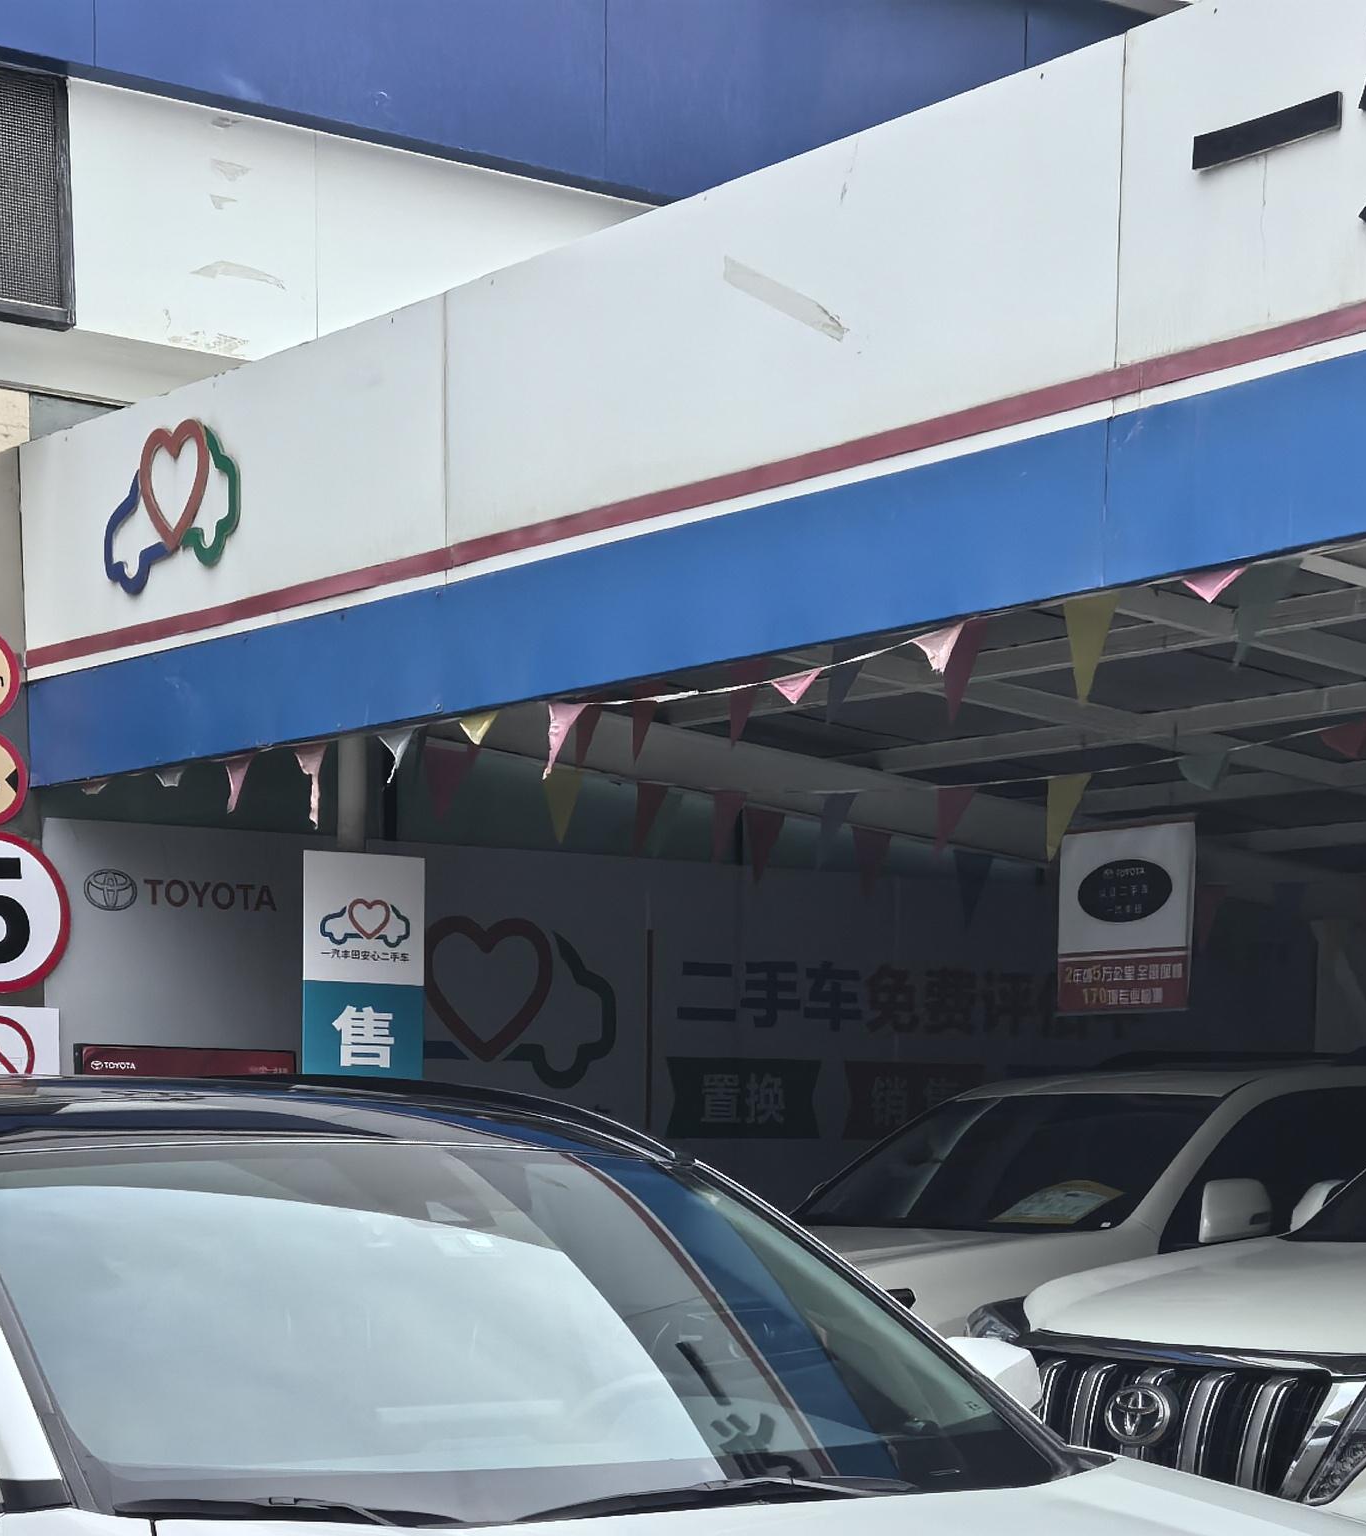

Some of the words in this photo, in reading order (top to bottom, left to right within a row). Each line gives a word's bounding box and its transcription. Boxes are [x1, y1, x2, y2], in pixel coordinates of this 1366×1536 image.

[144, 879, 277, 912] TOYOTA
[320, 948, 411, 962] 一汽丰田安心二手车
[331, 1005, 395, 1069] 售
[102, 1060, 137, 1071] TOYOTA
[698, 1071, 786, 1126] 置换
